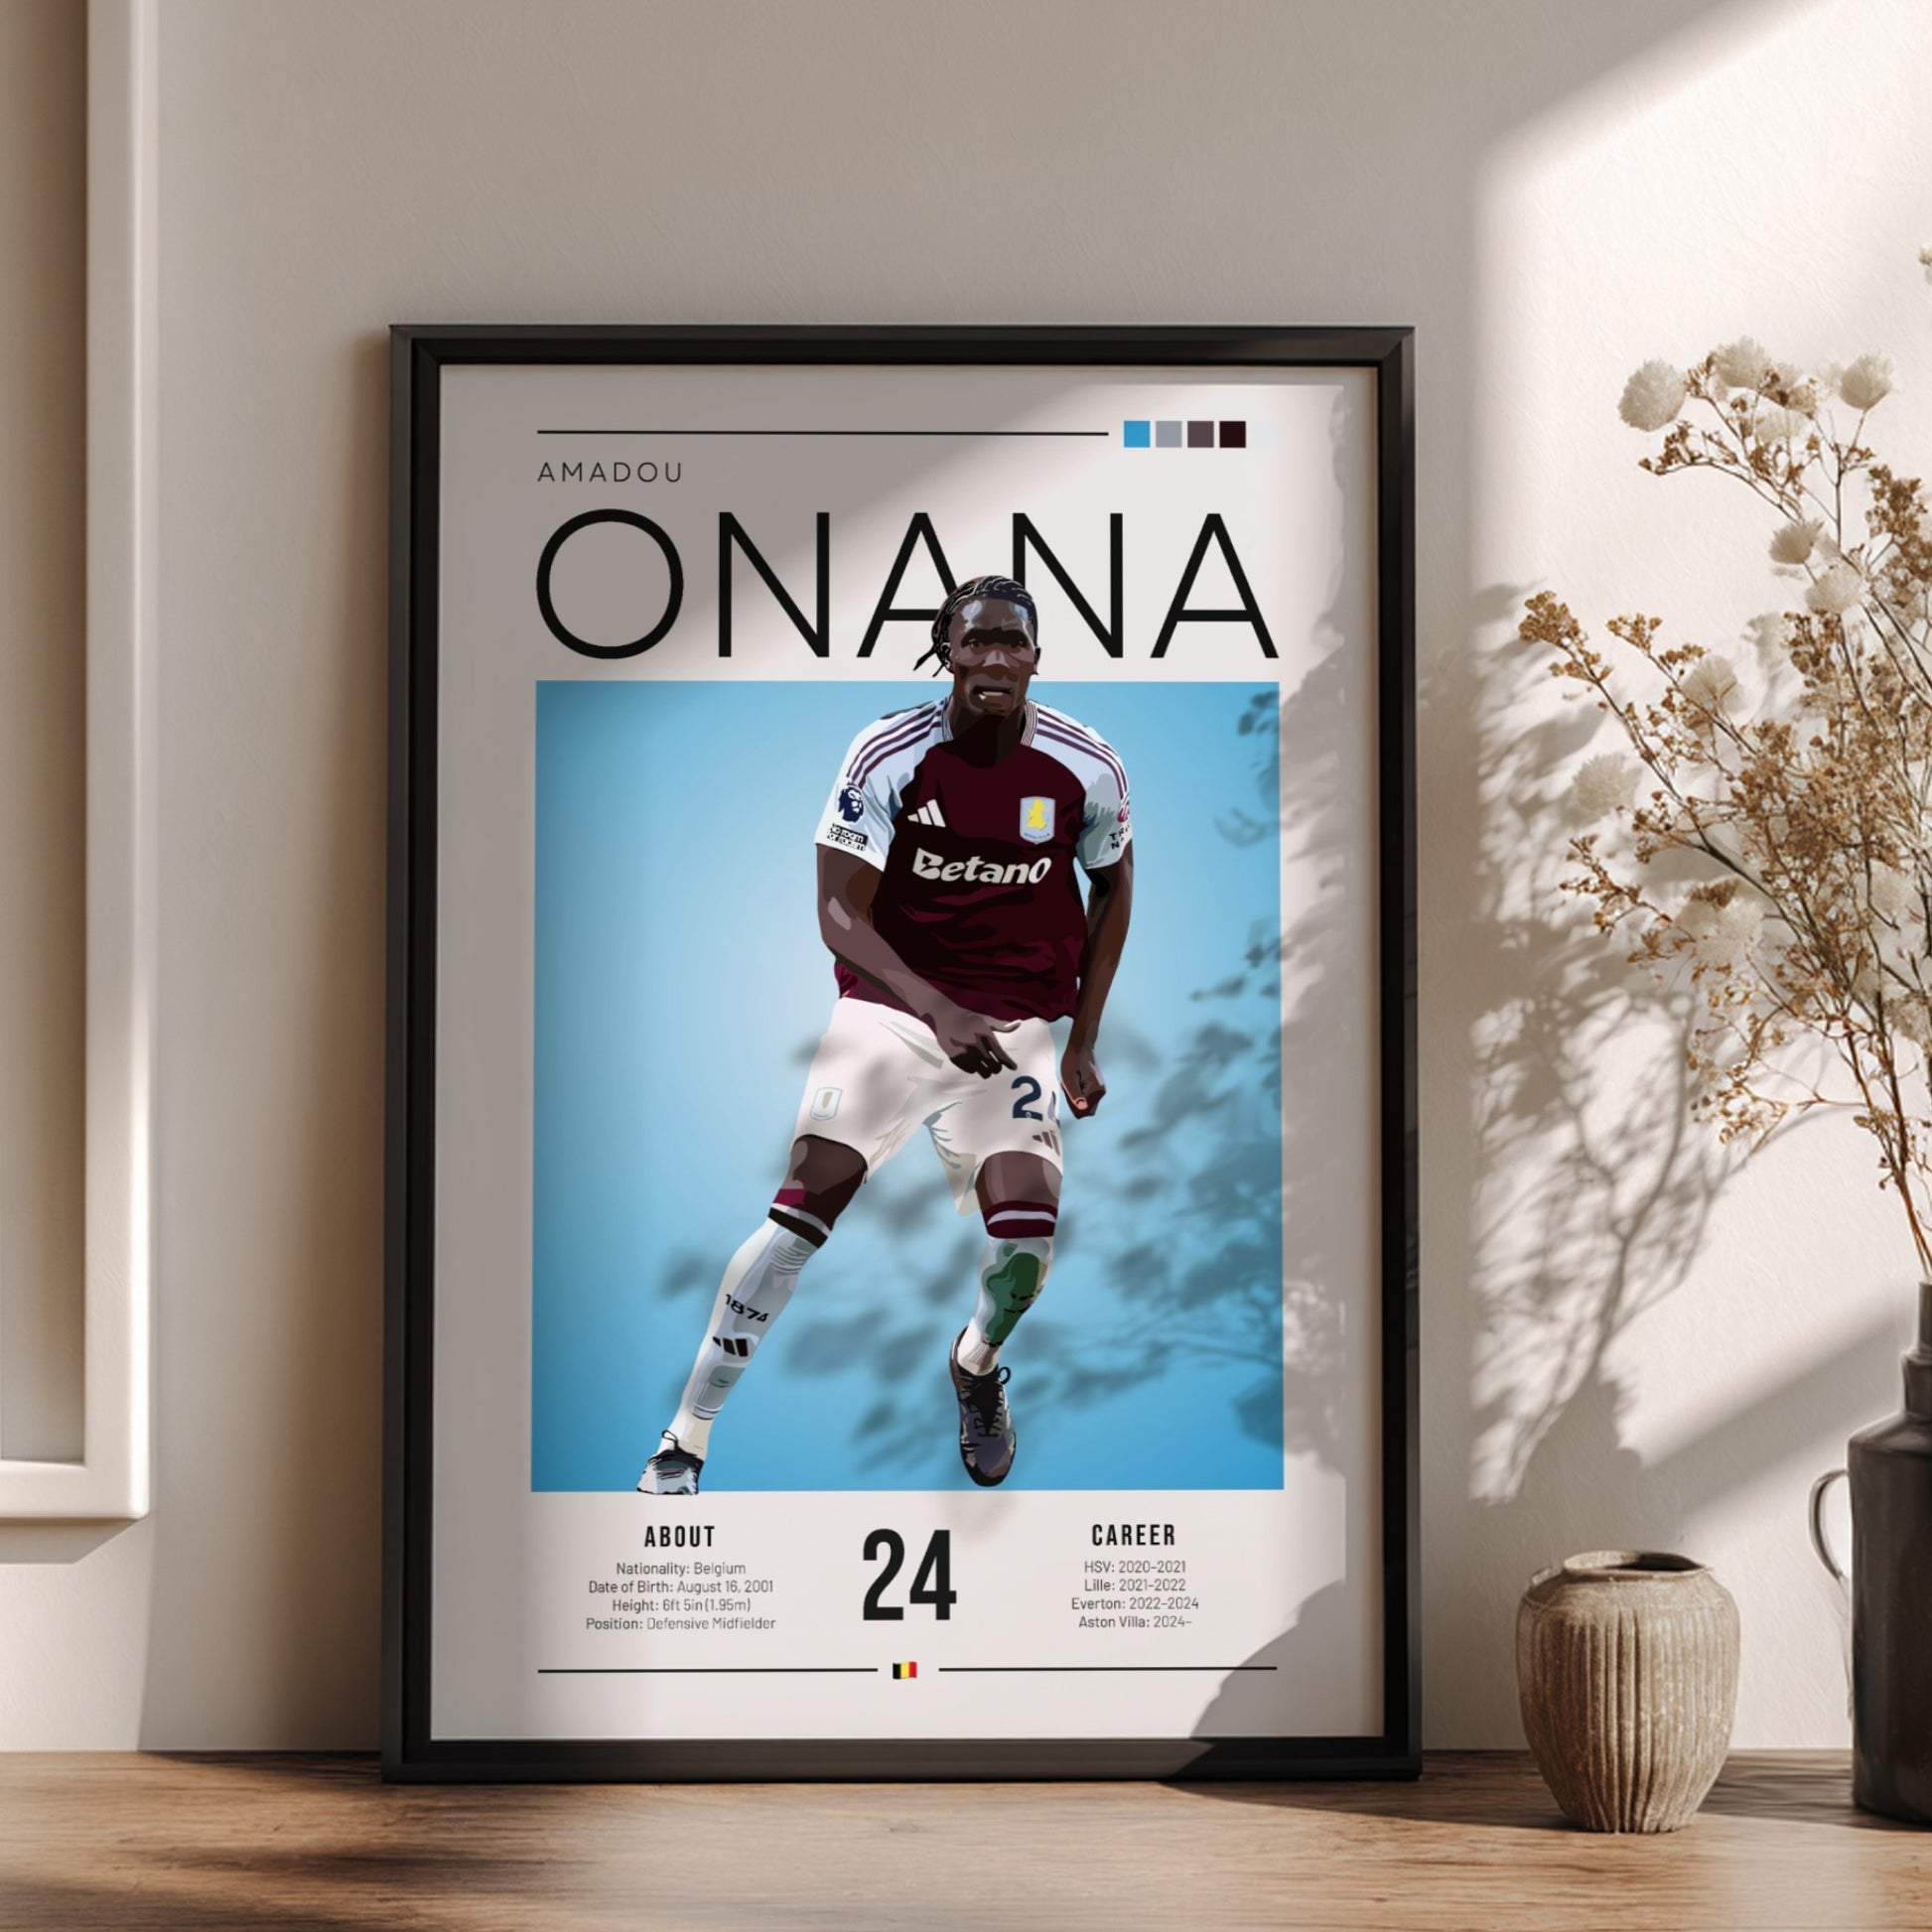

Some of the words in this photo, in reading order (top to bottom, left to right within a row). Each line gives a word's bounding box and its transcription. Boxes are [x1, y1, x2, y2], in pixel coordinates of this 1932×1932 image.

[537, 462, 682, 483] AMADOU
[536, 507, 1279, 659] ONANA
[644, 1525, 715, 1548] ABOUT
[1092, 1524, 1175, 1546] CAREER
[616, 1562, 690, 1577] Nationality:
[693, 1562, 746, 1577] Belgium
[863, 1529, 956, 1620] 24
[1084, 1561, 1115, 1574] HSV:
[1118, 1560, 1186, 1574] 2020-2021
[588, 1581, 619, 1593] Date
[621, 1581, 634, 1593] of
[637, 1581, 674, 1593] Birth:
[676, 1581, 723, 1595] August
[725, 1580, 742, 1594] 16,
[744, 1580, 773, 1593] 2001
[1084, 1579, 1116, 1591] Lille:
[1119, 1579, 1186, 1591] 2021-2022
[612, 1599, 659, 1614] Height:
[662, 1598, 681, 1611] 6ft
[683, 1598, 703, 1611] 5in
[705, 1598, 752, 1613] (1.95m)
[1071, 1597, 1126, 1609] Everton:
[1129, 1596, 1199, 1609] 2022-2024
[586, 1618, 643, 1630] Position:
[646, 1617, 710, 1630] Defensive
[712, 1617, 776, 1630] Midfielder
[1078, 1616, 1116, 1628] Aston
[1119, 1615, 1151, 1628] Villa:
[1153, 1615, 1192, 1628] 2024-
